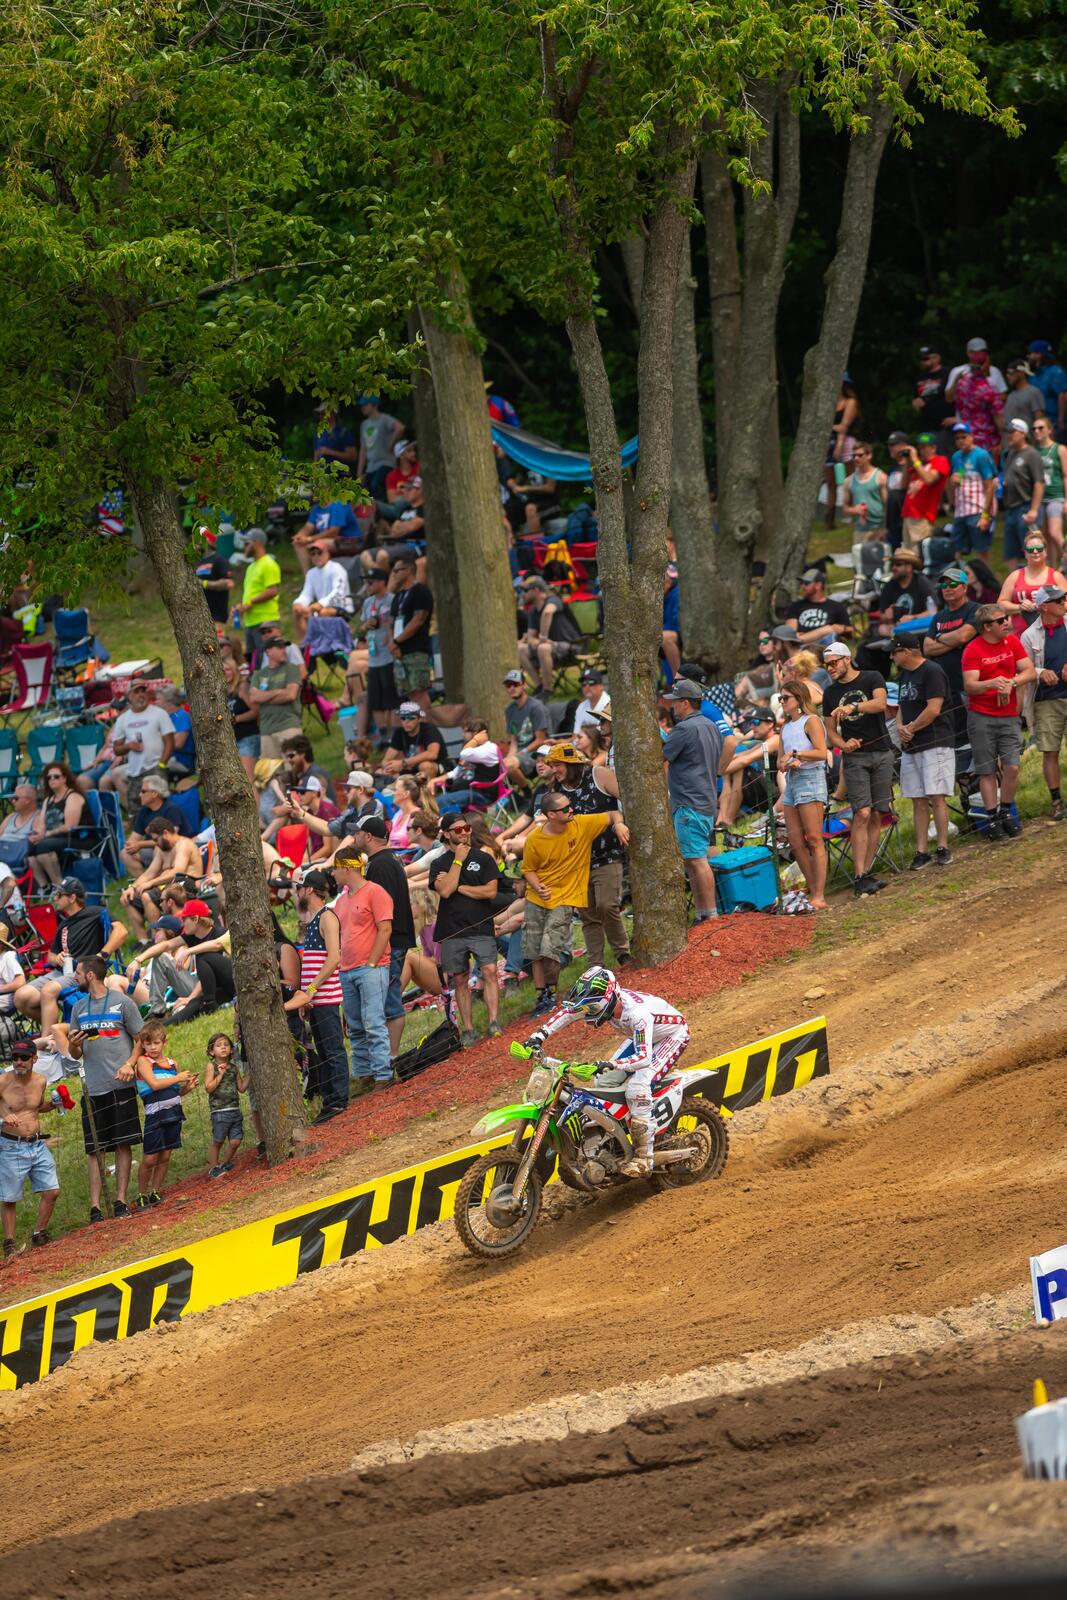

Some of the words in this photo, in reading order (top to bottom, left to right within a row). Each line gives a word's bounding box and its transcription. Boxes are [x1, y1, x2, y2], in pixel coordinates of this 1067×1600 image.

[1016, 590, 1039, 603] US
[466, 861, 481, 872] 50
[80, 1022, 115, 1031] HONDA
[0, 1257, 194, 1391] HOR
